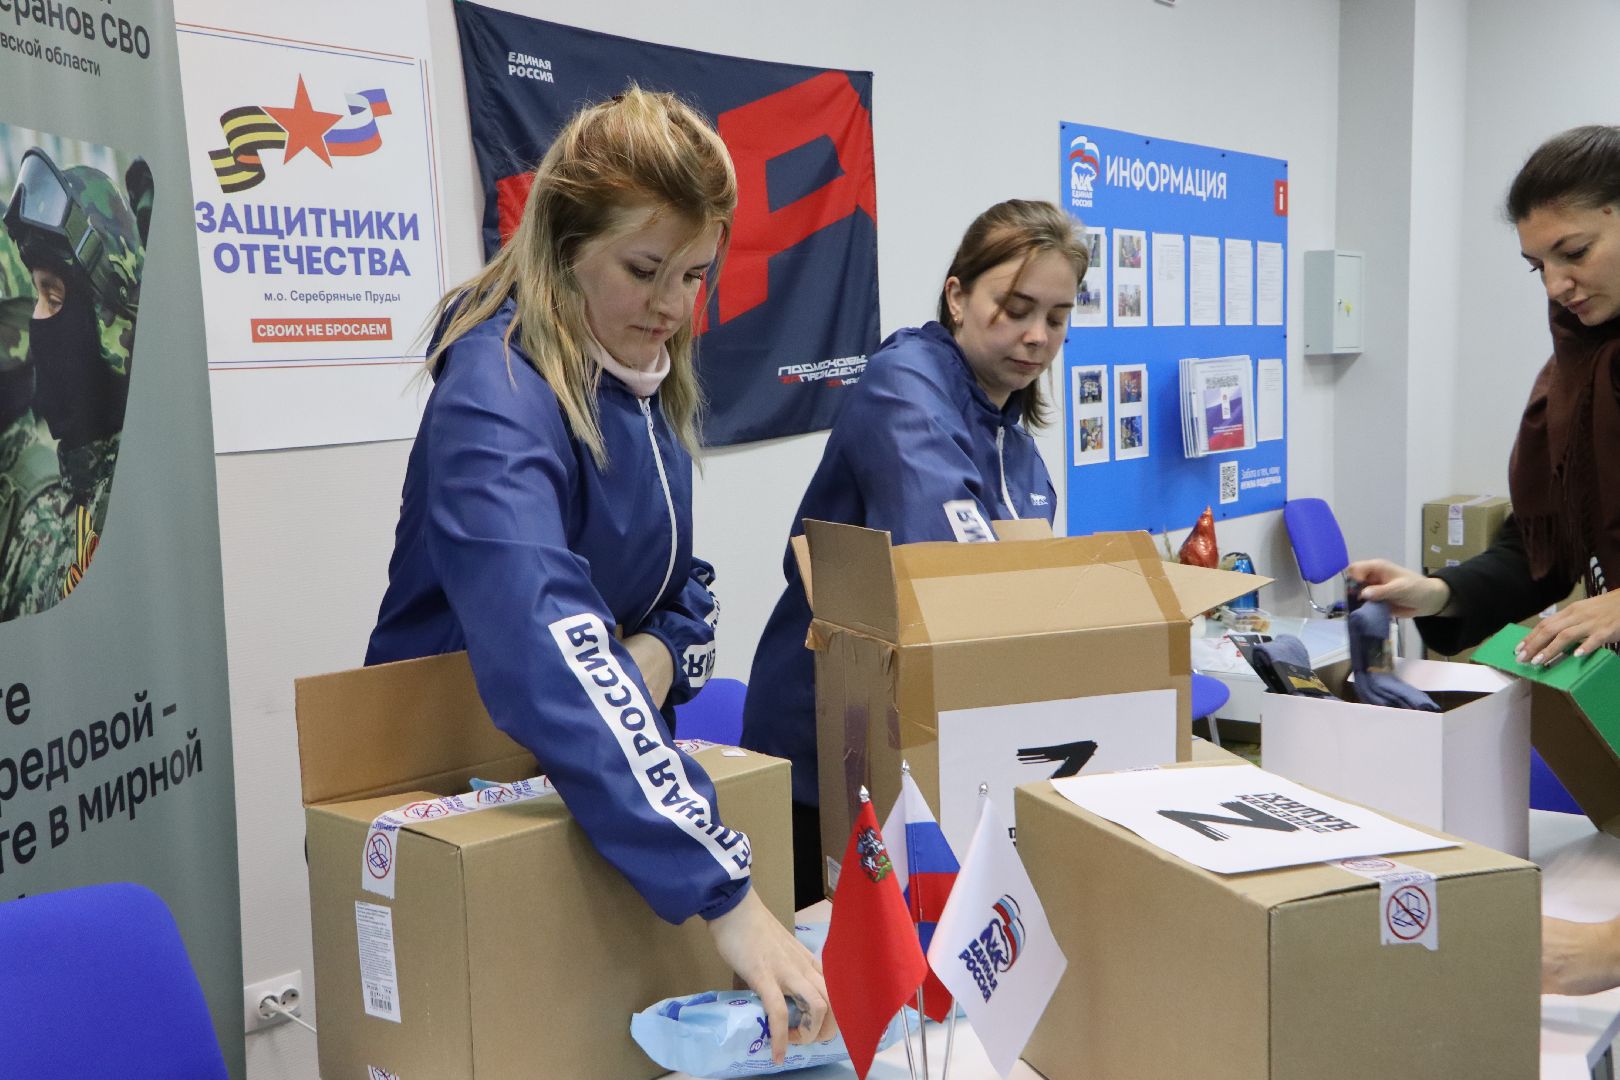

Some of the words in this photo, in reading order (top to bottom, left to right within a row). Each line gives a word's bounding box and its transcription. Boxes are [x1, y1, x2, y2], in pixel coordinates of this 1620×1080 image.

[101, 13, 150, 59] СВО
[45, 46, 101, 77] области
[508, 51, 552, 71] ЕДИНАЯ
[508, 64, 554, 83] РОССИЯ
[1106, 155, 1227, 201] ИНФОРМАЦИЯ
[195, 201, 420, 241] ЗАЩИТНИКИ
[213, 242, 411, 276] ОТЕЧЕСТВА
[264, 292, 287, 301] м.о.
[290, 290, 362, 304] Серебряные
[365, 290, 401, 304] Пруды
[257, 324, 304, 337] СВОИХ
[306, 324, 324, 336] НЕ
[326, 323, 387, 336] БРОСАЕМ
[565, 622, 661, 757] РОССИЯ
[49, 805, 70, 849] в
[78, 727, 203, 832] мирной
[958, 949, 991, 1003] РОССИЯ
[969, 939, 998, 991] ЕДИНАЯ
